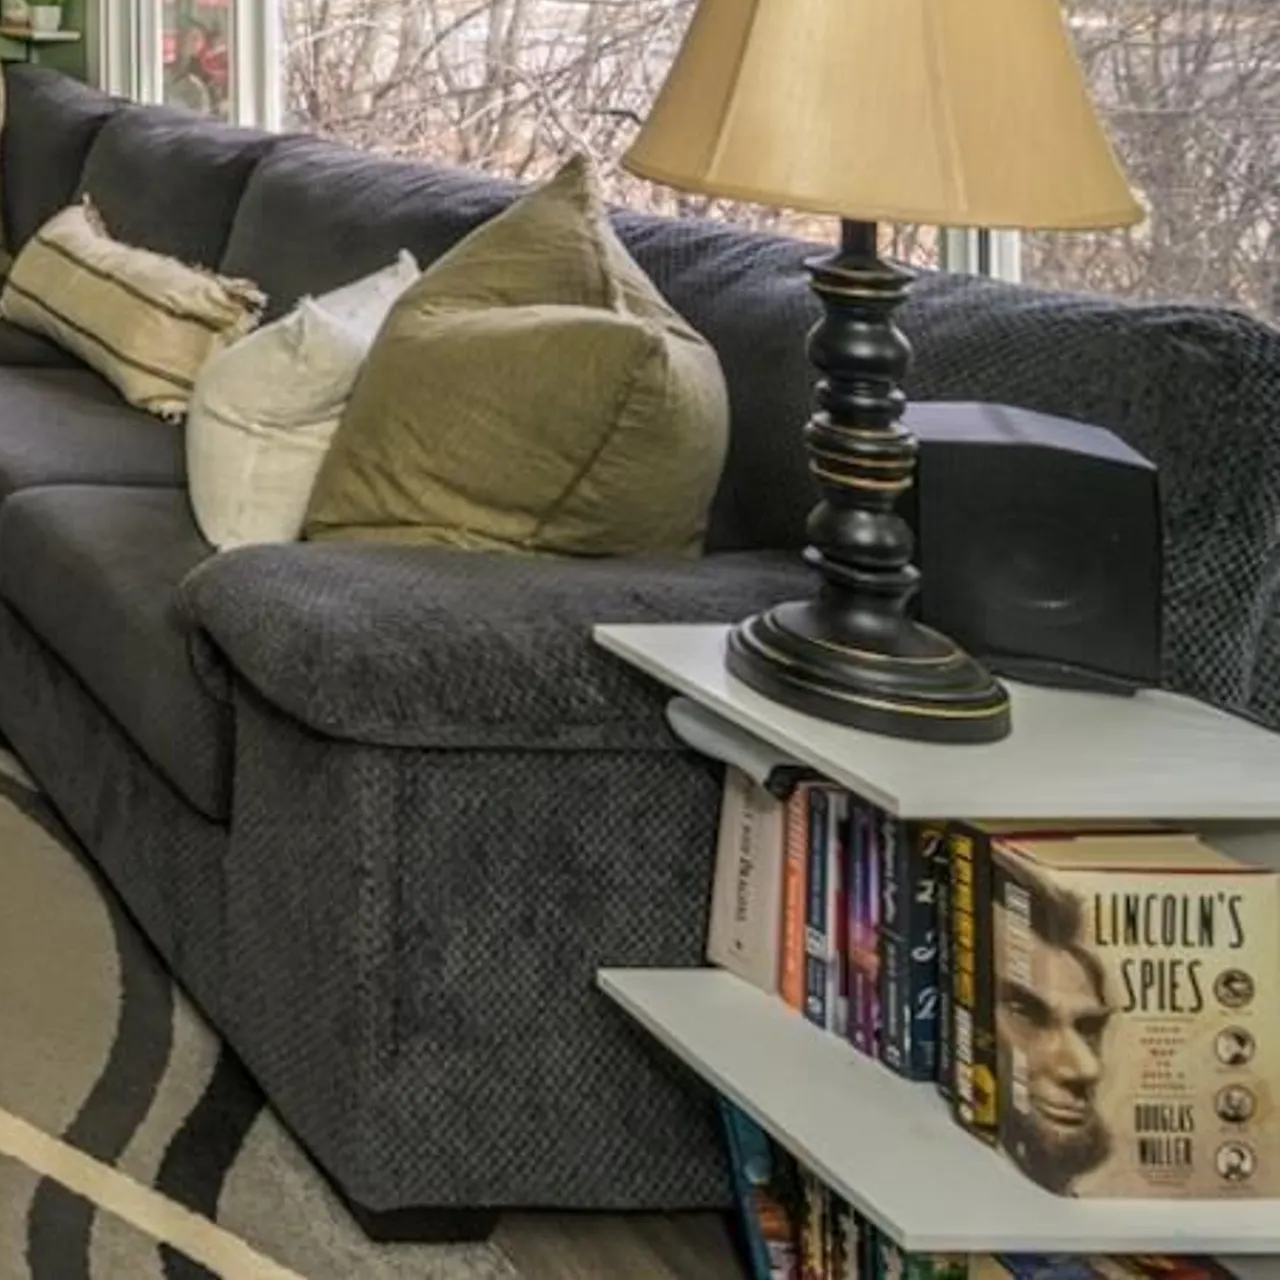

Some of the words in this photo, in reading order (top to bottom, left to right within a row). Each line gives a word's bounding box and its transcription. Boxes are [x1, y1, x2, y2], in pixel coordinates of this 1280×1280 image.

[1094, 892, 1245, 949] LINCOLN'S
[1120, 958, 1204, 1014] SPIES
[1134, 1104, 1196, 1133] DOUGLAS
